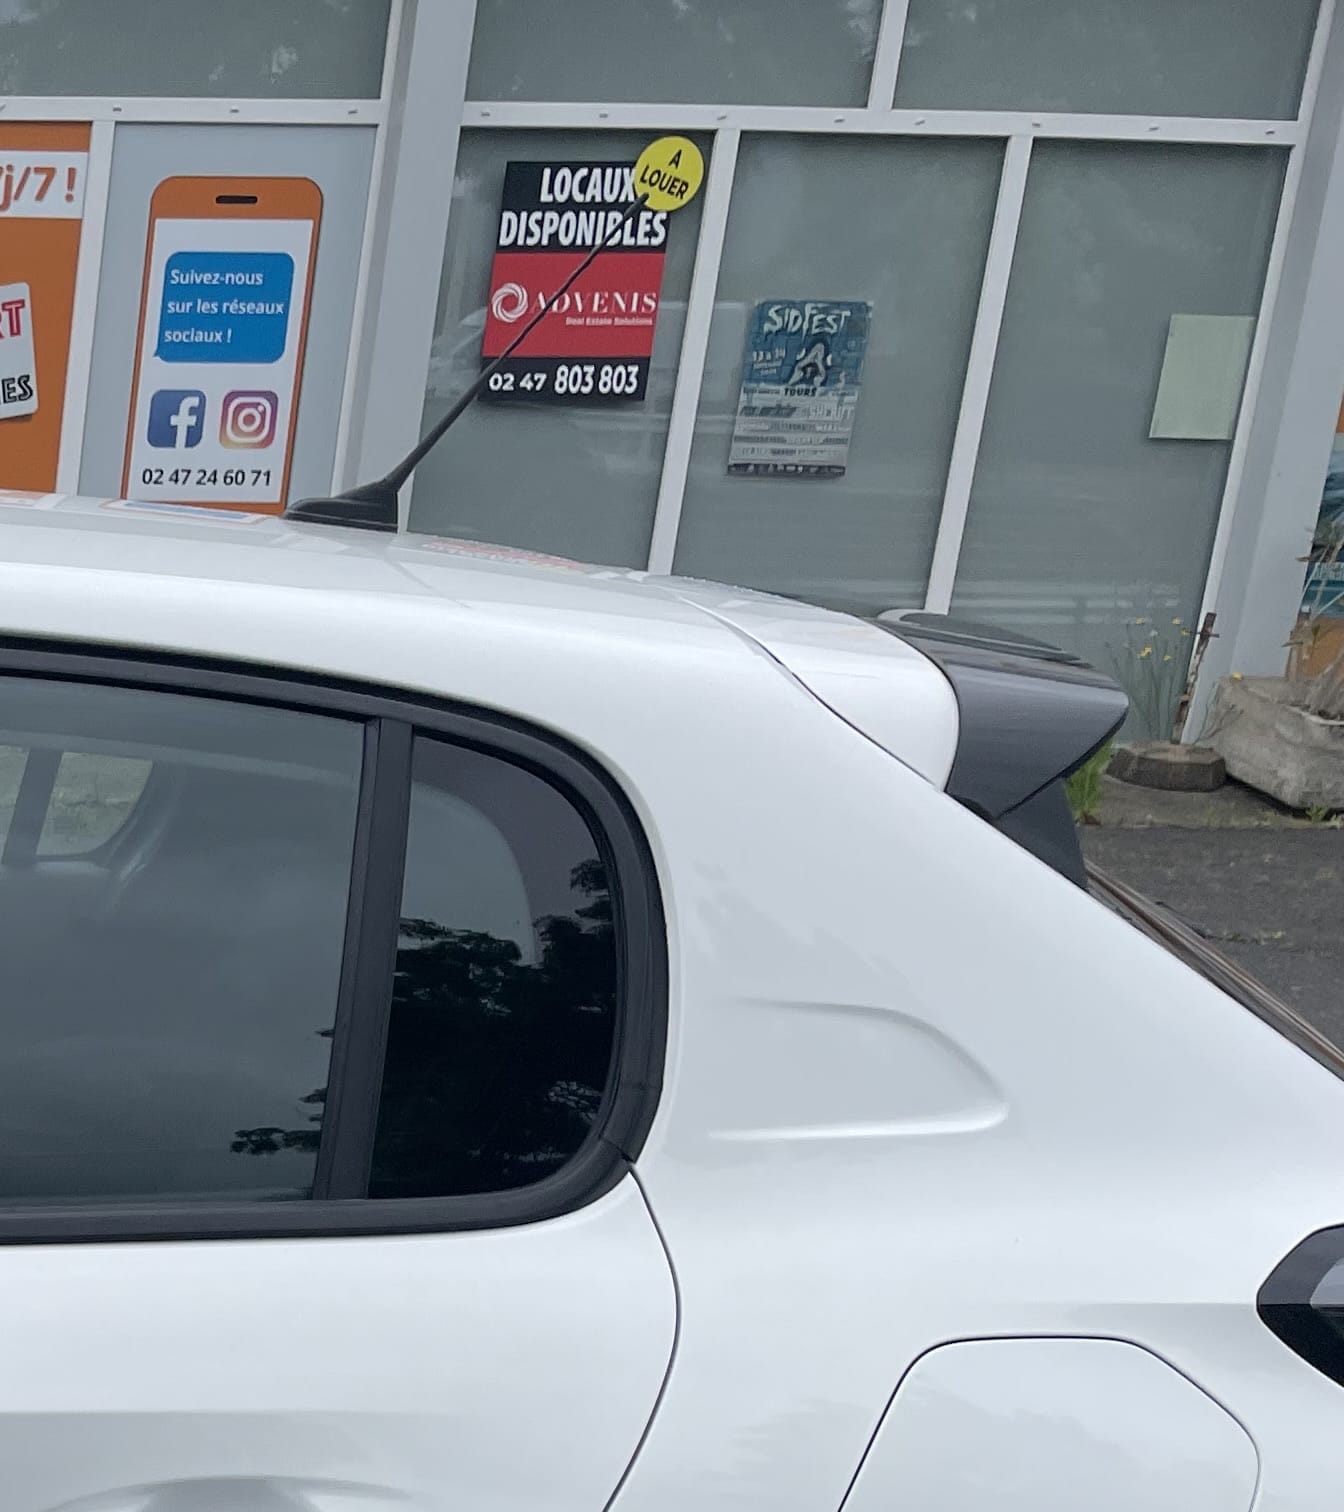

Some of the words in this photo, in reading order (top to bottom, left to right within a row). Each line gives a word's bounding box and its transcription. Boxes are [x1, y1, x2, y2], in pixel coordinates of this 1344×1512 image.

[668, 150, 684, 169] A
[539, 167, 636, 203] LOCAUX
[639, 165, 690, 200] LOUER
[498, 210, 668, 247] DISPONIBLES
[170, 269, 264, 286] Suivez-nous
[167, 301, 193, 314] sur
[197, 299, 218, 314] les
[222, 298, 284, 315] réseaux
[530, 291, 657, 314] ADVENIS
[164, 327, 223, 343] sociaux
[488, 373, 514, 391] 02
[519, 373, 547, 391] 47
[554, 364, 595, 394] 803
[598, 364, 639, 394] 803
[784, 387, 817, 397] TOURS
[142, 468, 164, 485] 02
[168, 469, 191, 485] 47
[196, 469, 217, 486] 24
[223, 470, 246, 486] 60
[251, 470, 271, 486] 71
